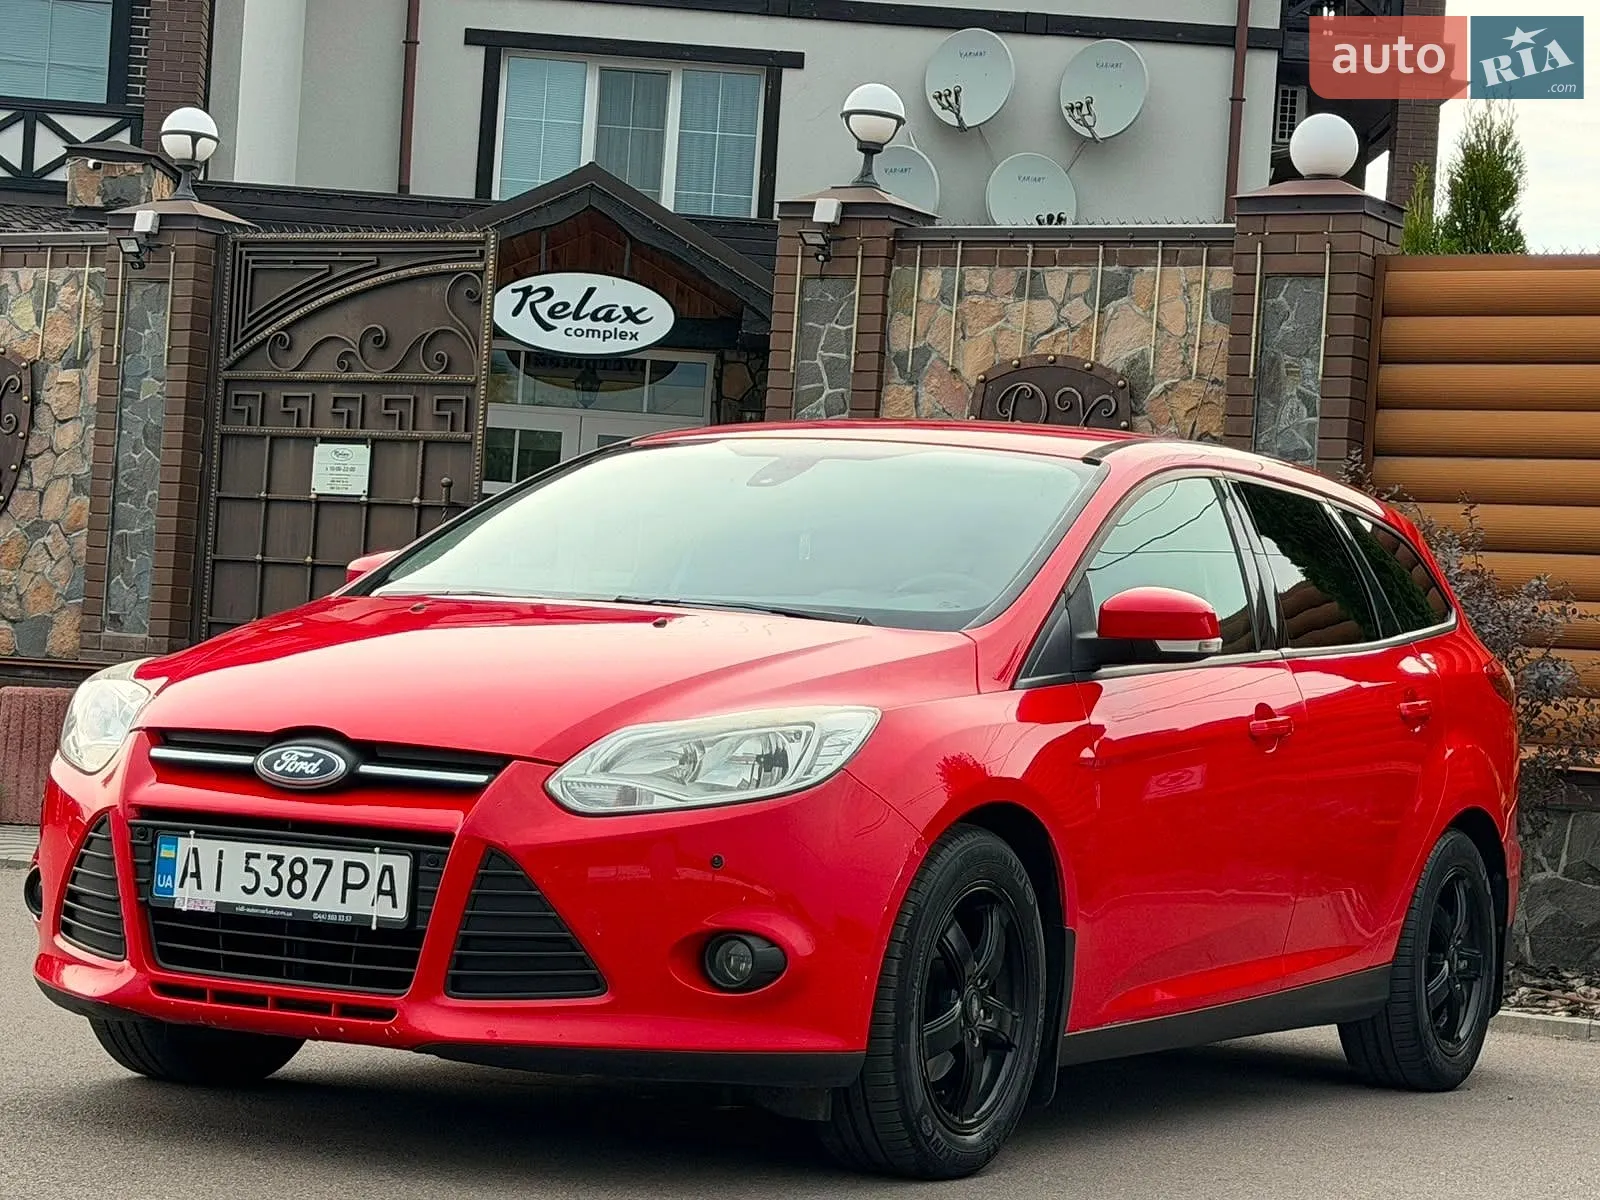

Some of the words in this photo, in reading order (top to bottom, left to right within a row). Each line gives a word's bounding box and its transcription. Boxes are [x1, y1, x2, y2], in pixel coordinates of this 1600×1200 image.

[511, 285, 654, 332] Relax
[564, 326, 639, 342] complex
[273, 750, 324, 775] Ford
[157, 874, 173, 888] UA
[178, 846, 224, 893] AI
[240, 851, 334, 902] 5387
[340, 860, 399, 909] PA
